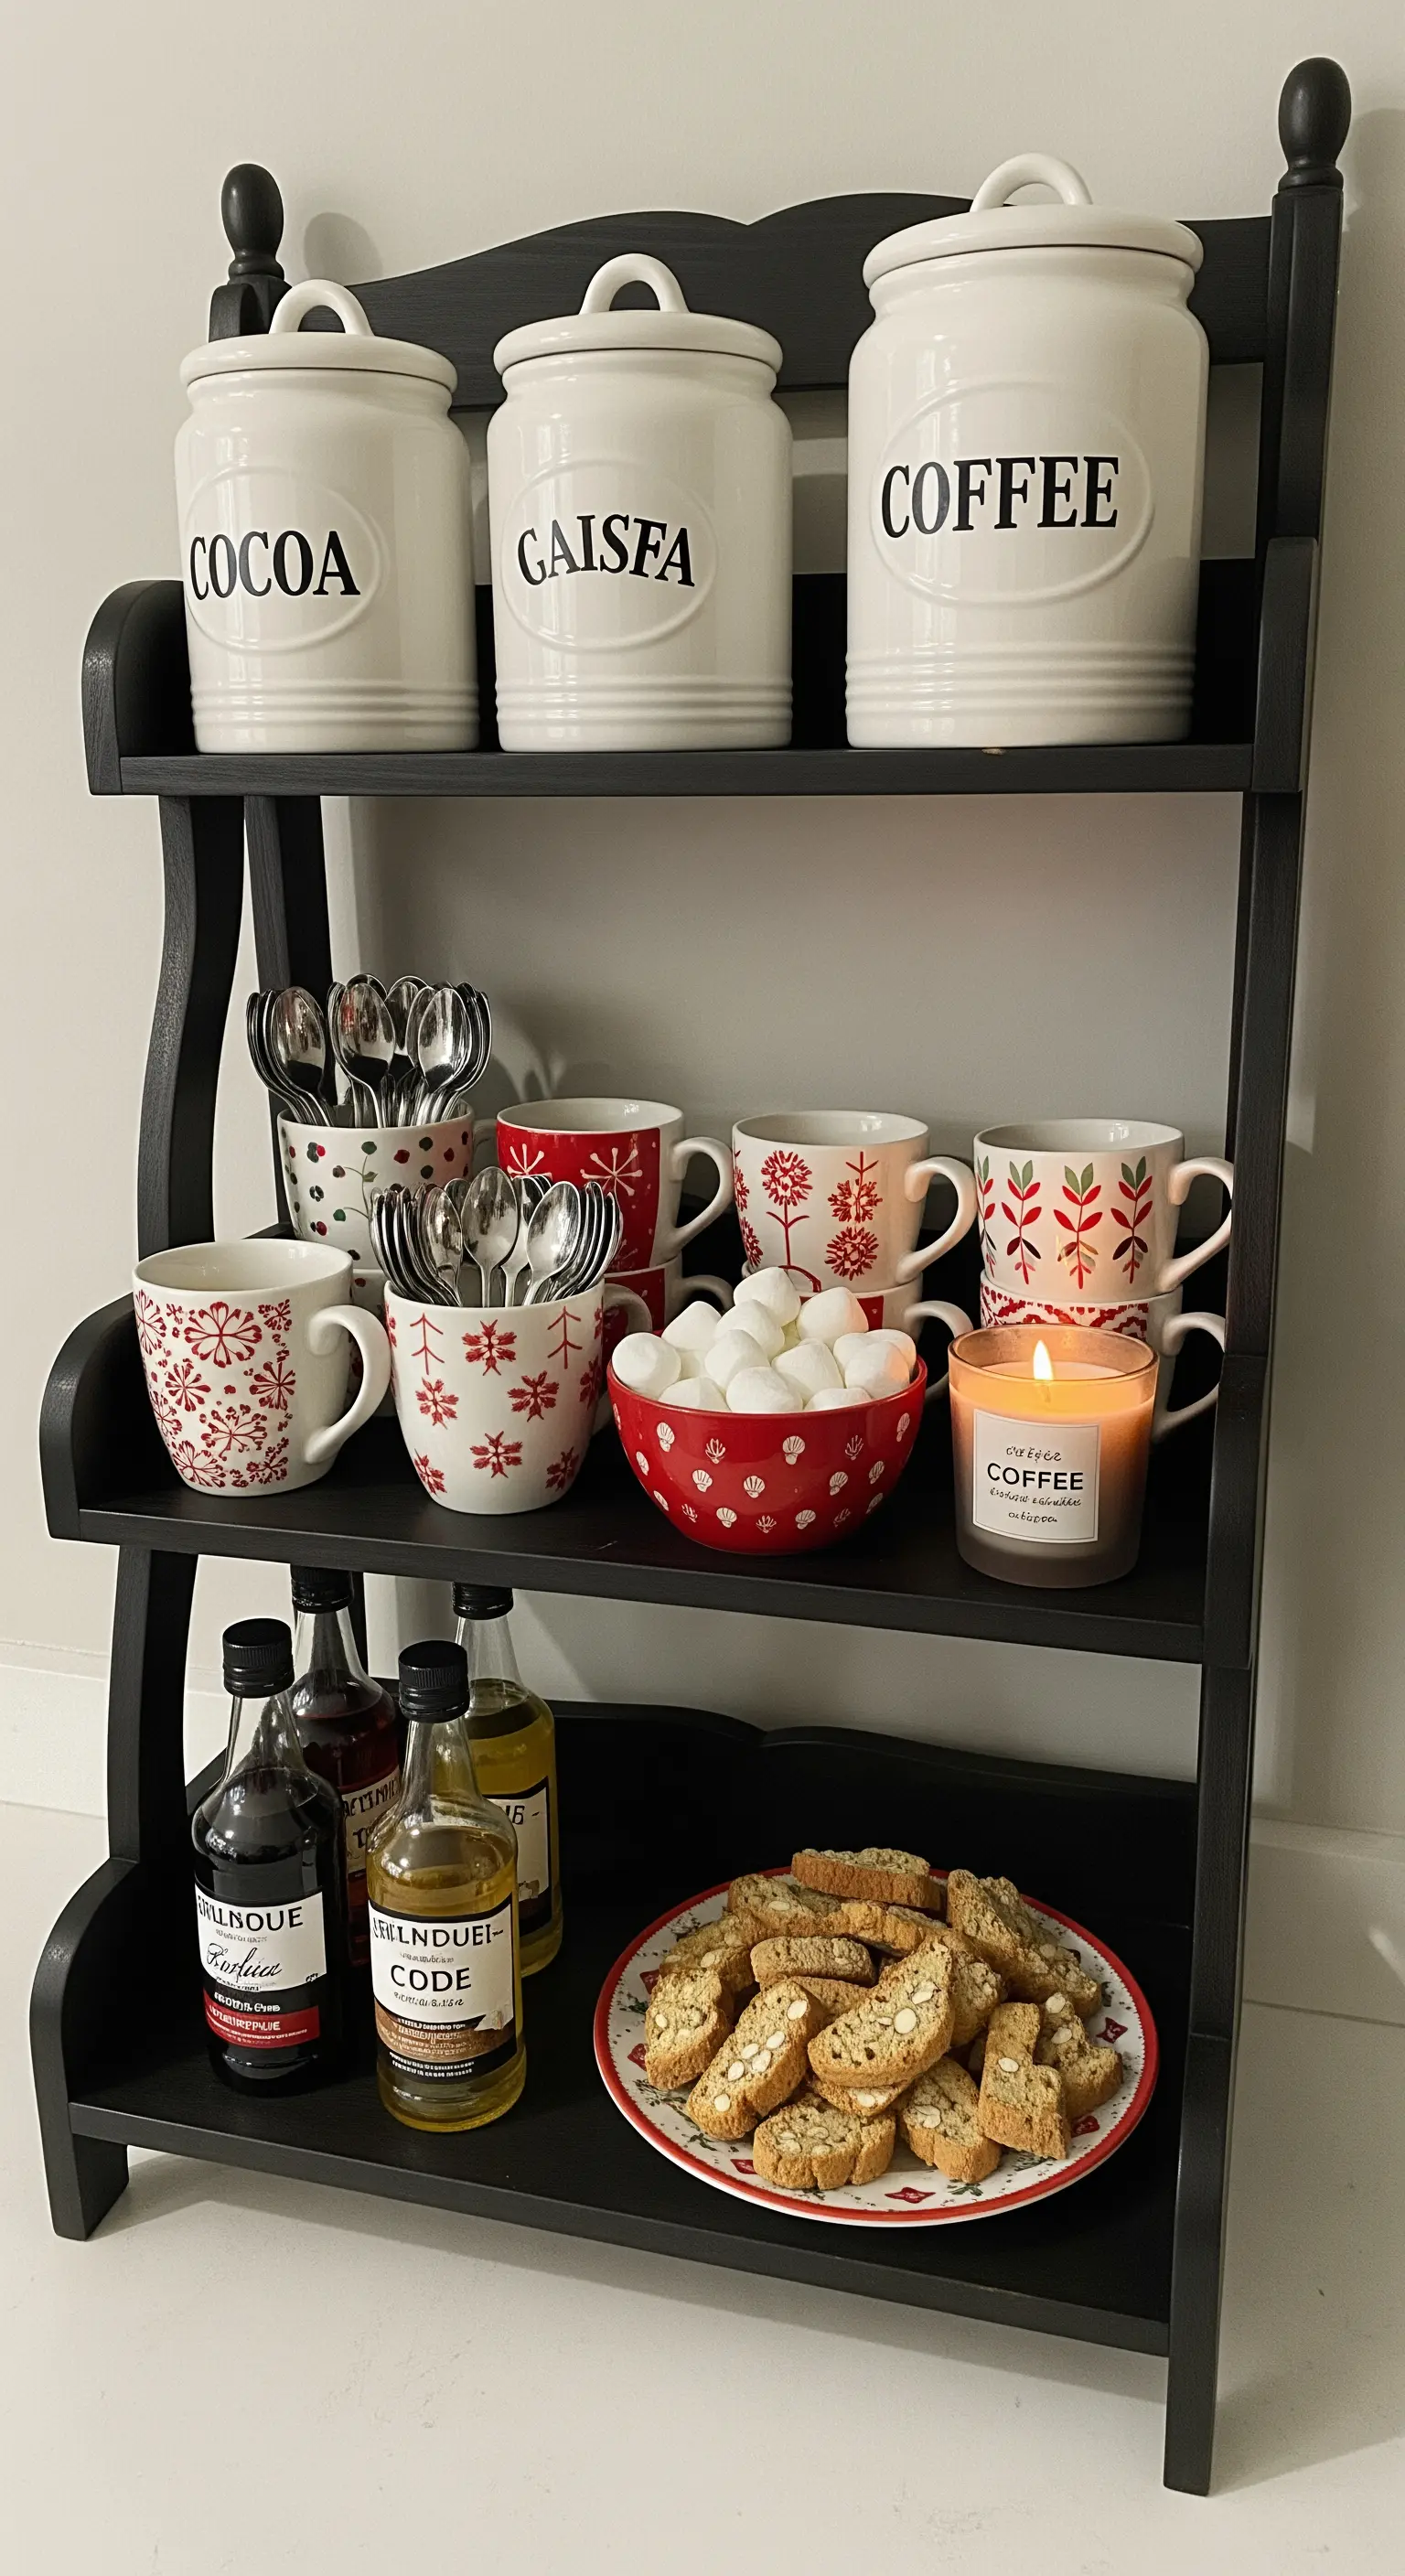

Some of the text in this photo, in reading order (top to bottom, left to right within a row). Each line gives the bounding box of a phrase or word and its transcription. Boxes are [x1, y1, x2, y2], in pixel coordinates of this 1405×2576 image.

[882, 456, 1119, 538] COFFEE
[189, 531, 360, 600] COCOA
[517, 514, 695, 587] GAISFA
[987, 1462, 1084, 1490] COFFEE
[391, 1964, 472, 1992] CODE
